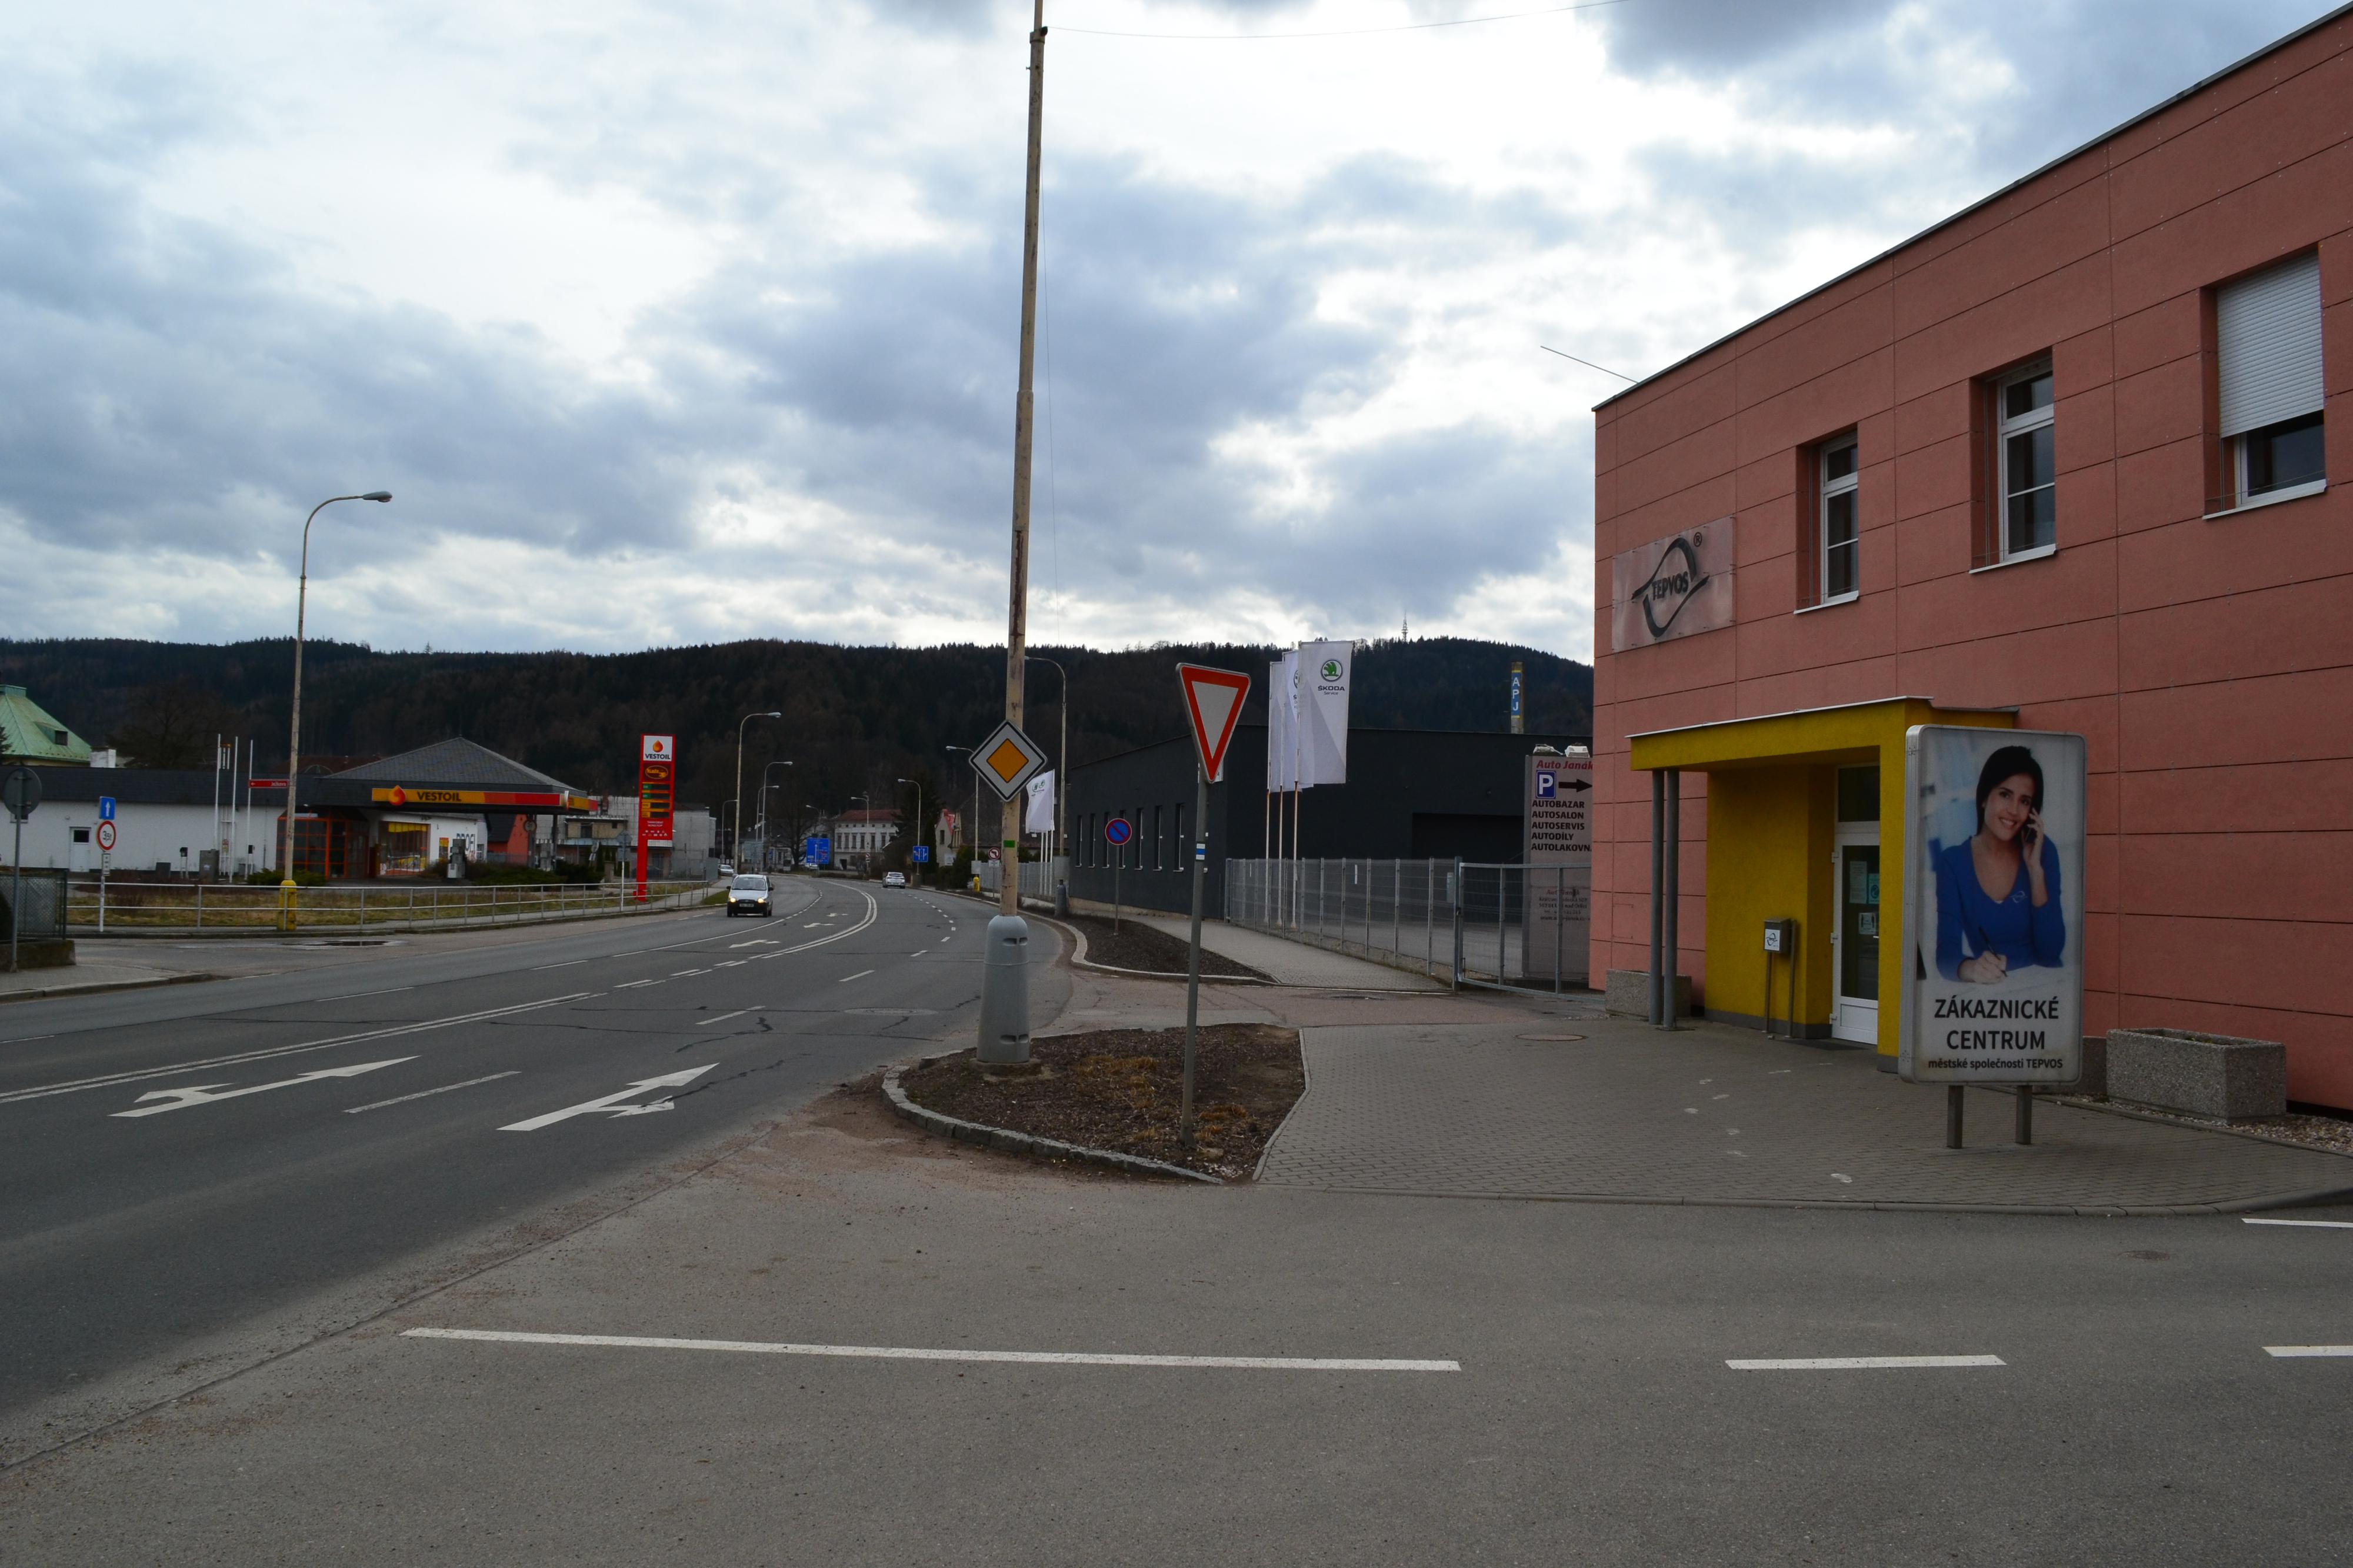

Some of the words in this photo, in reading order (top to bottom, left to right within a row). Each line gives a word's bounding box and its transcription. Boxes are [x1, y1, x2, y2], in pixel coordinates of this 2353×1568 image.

[1652, 571, 1689, 600] TEPVOS
[1537, 760, 1561, 769] Auto
[1539, 775, 1553, 795] P
[416, 792, 462, 802] VESTOIL
[1532, 800, 1585, 809] AUTOBAZAR
[1532, 810, 1584, 820] AUTOSALON
[1531, 822, 1585, 830] AUTOSERVIS
[1531, 832, 1574, 840] AUTODÍLY
[1531, 843, 1592, 852] AUTOLAKOVN
[1934, 995, 2059, 1019] ZÁKAZNICKÉ
[1947, 1030, 2045, 1050] CENTRUM
[1928, 1058, 1967, 1068] městské
[1970, 1058, 2023, 1070] společnosti
[2026, 1059, 2063, 1069] TEPVOS
